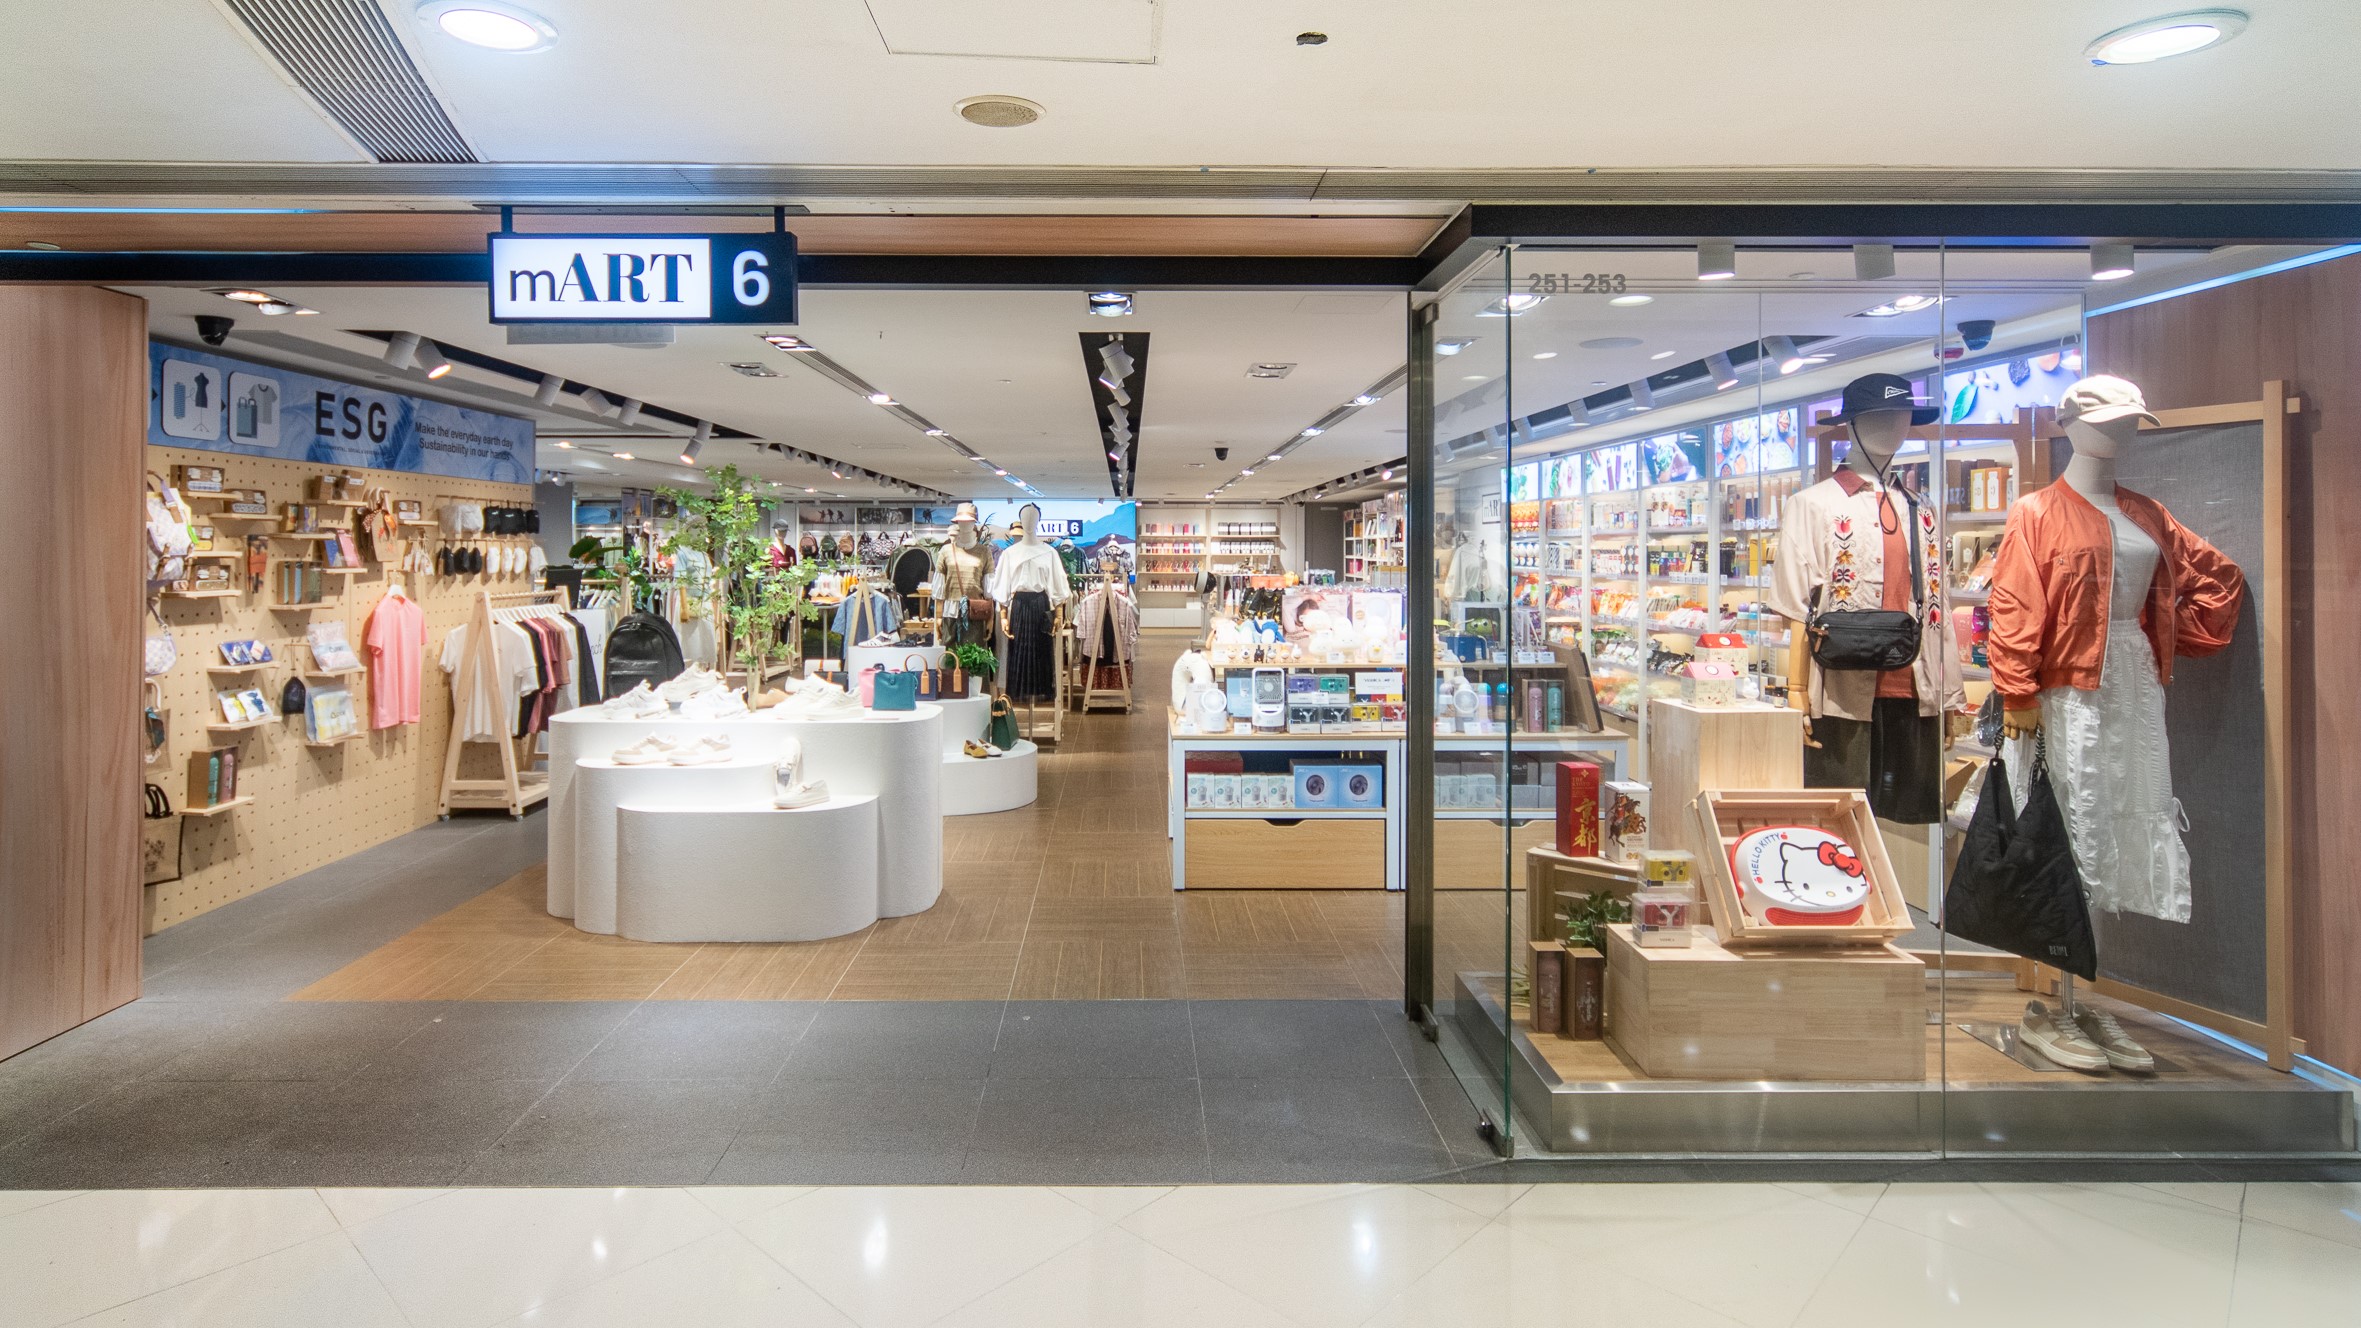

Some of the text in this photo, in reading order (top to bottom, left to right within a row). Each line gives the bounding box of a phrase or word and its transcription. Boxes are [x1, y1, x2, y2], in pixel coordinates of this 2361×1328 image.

[509, 250, 771, 307] mART 6
[1528, 273, 1627, 294] 251-253
[316, 390, 387, 444] ESG
[415, 422, 514, 450] Make the everyday earth day
[419, 437, 469, 457] Sustainability
[470, 446, 476, 456] in
[477, 449, 488, 458] our
[1484, 500, 1501, 517] mAR
[1036, 522, 1080, 534] ART 6
[1572, 798, 1598, 855] 京都
[1751, 832, 1781, 876] HELLO KITTY
